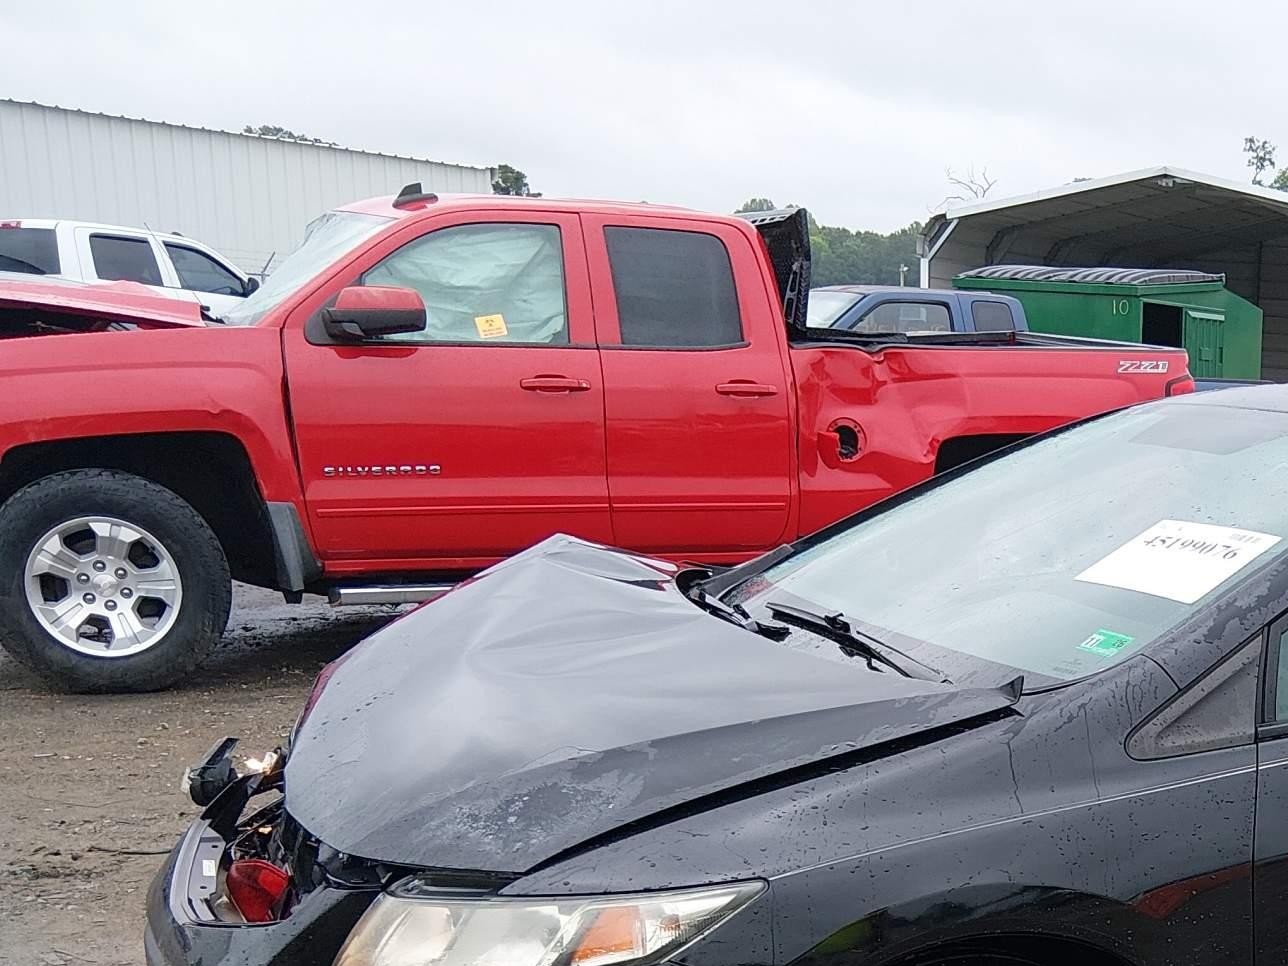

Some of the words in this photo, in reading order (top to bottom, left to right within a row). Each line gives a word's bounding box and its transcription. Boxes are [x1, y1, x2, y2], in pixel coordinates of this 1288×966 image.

[1112, 298, 1129, 316] 10
[323, 464, 441, 477] SILVERADO
[1143, 535, 1239, 560] 45199076
